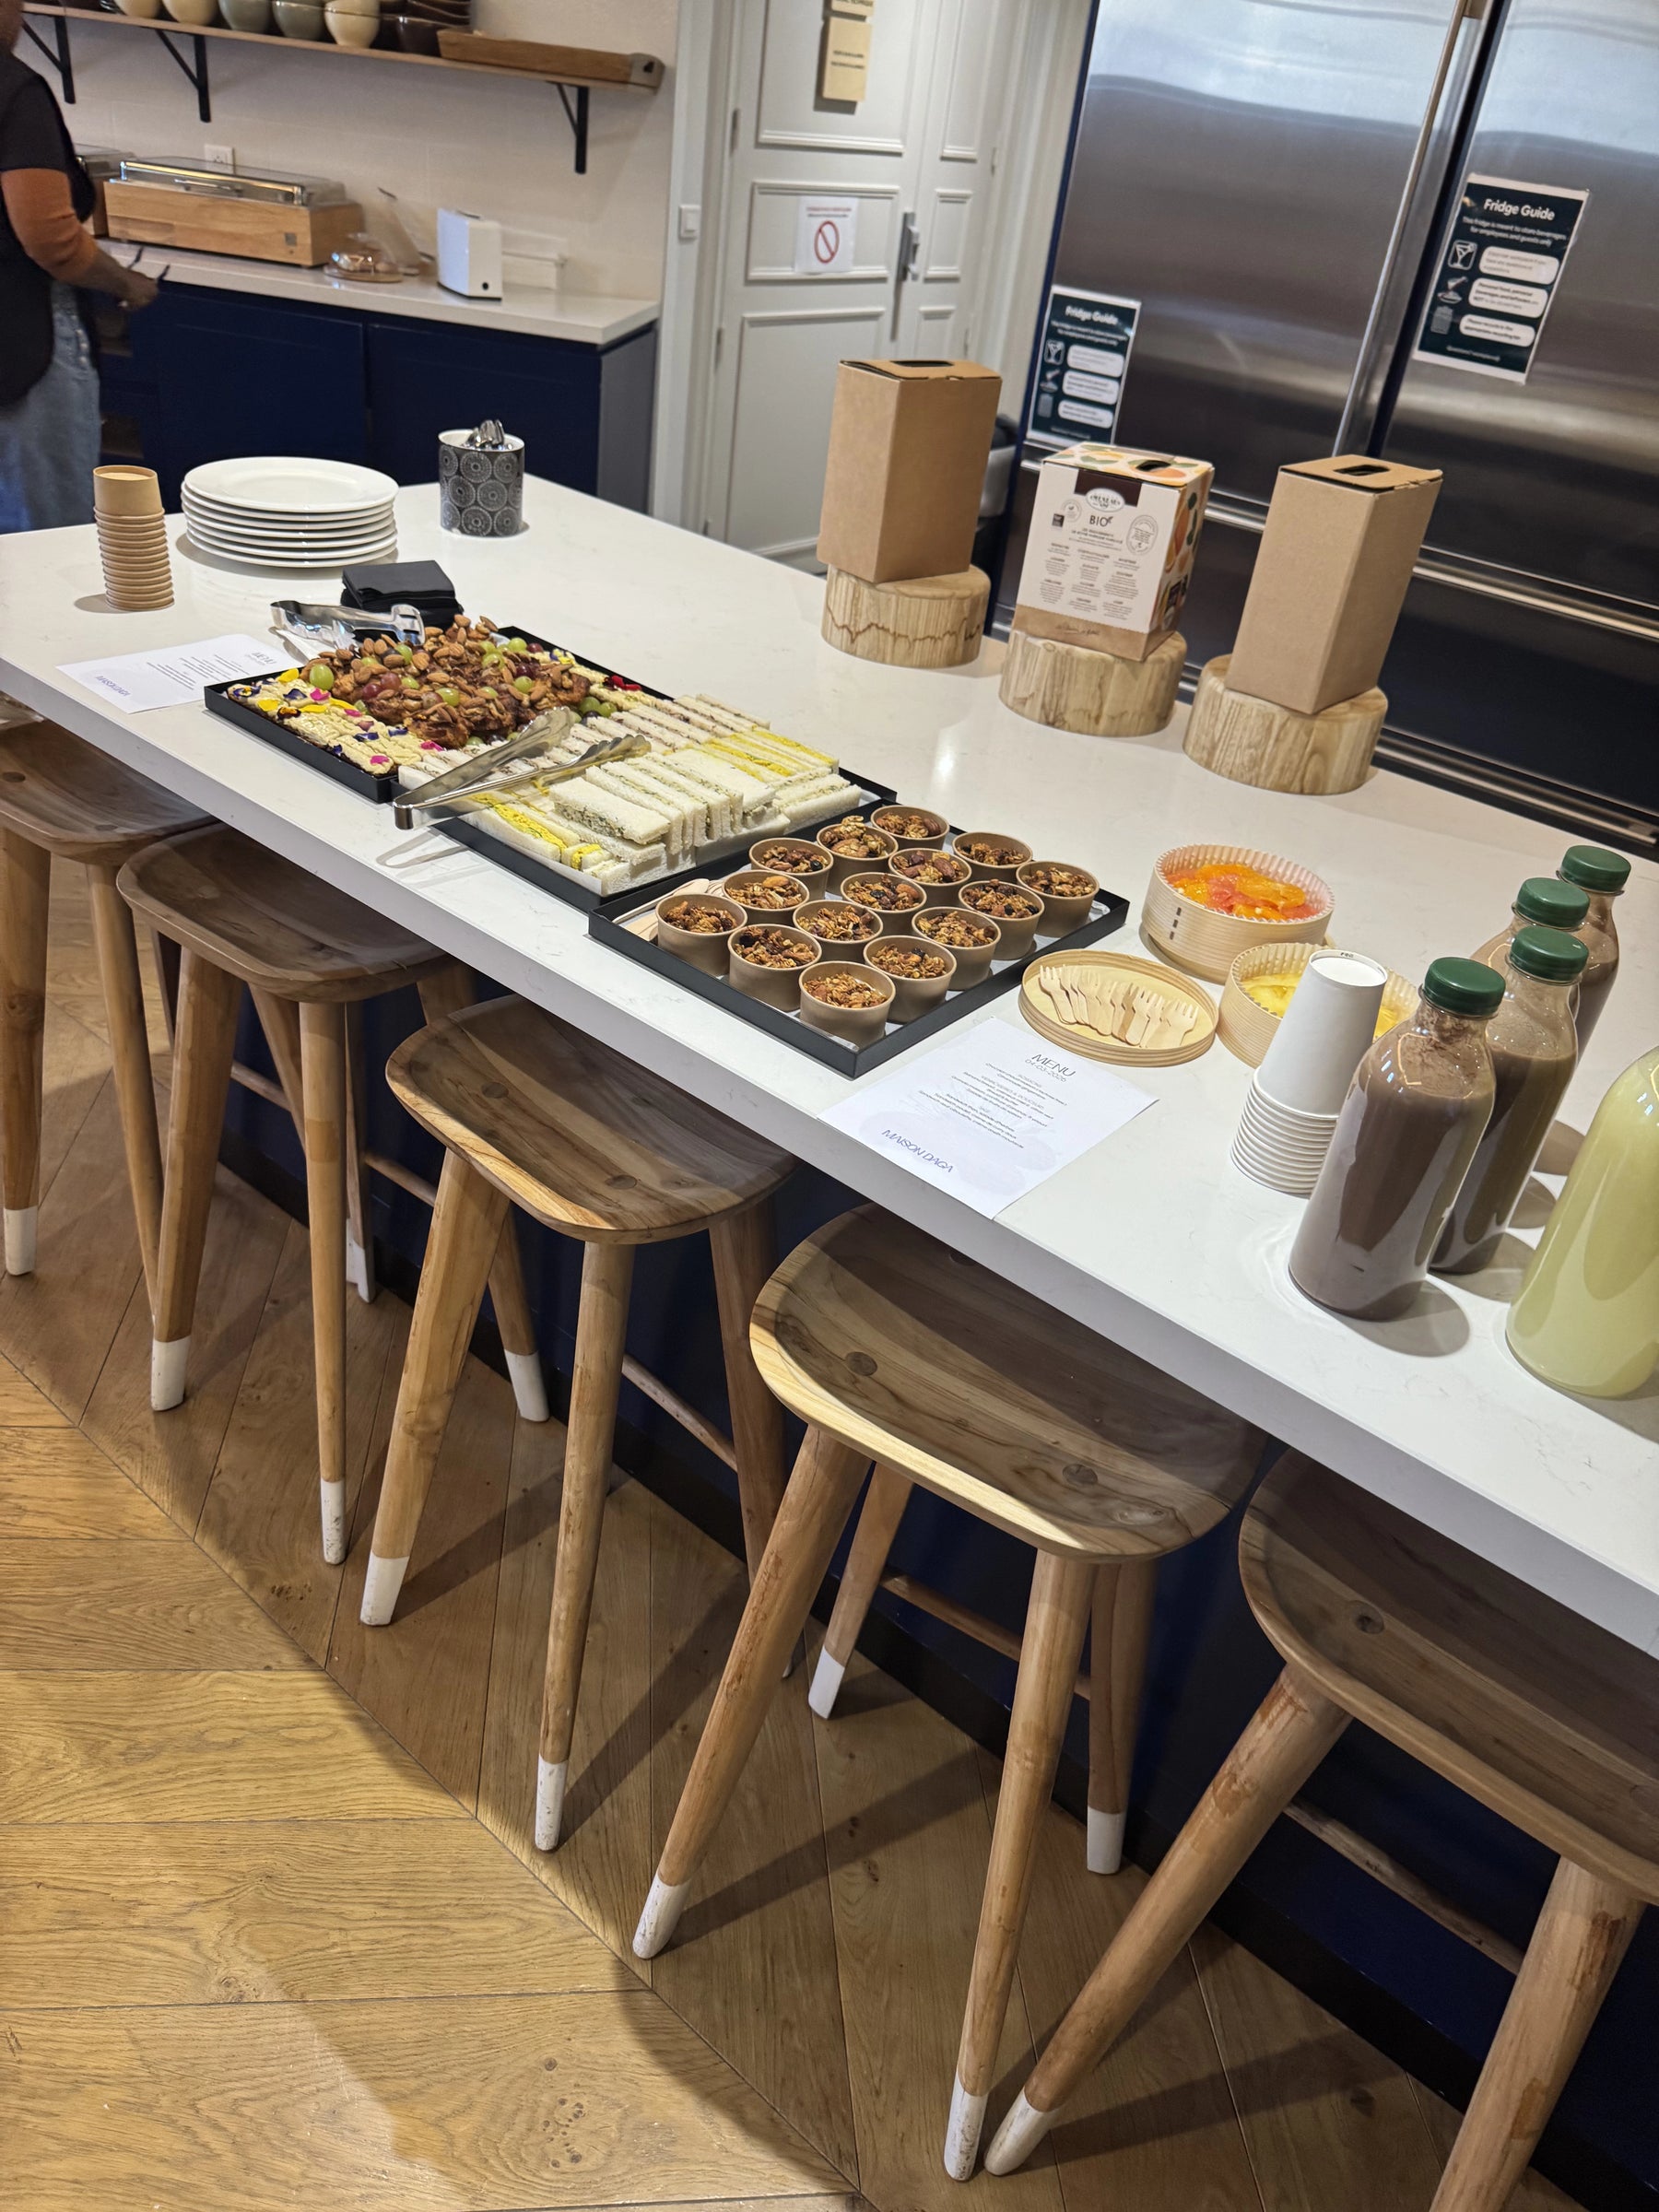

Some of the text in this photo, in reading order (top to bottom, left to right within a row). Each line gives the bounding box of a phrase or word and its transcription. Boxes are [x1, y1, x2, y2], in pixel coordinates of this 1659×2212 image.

[1483, 198, 1556, 221] Fridge Guide
[1089, 515, 1109, 527] BIO
[1031, 1053, 1077, 1077] MENU
[881, 1129, 954, 1172] MAISON DAGA
